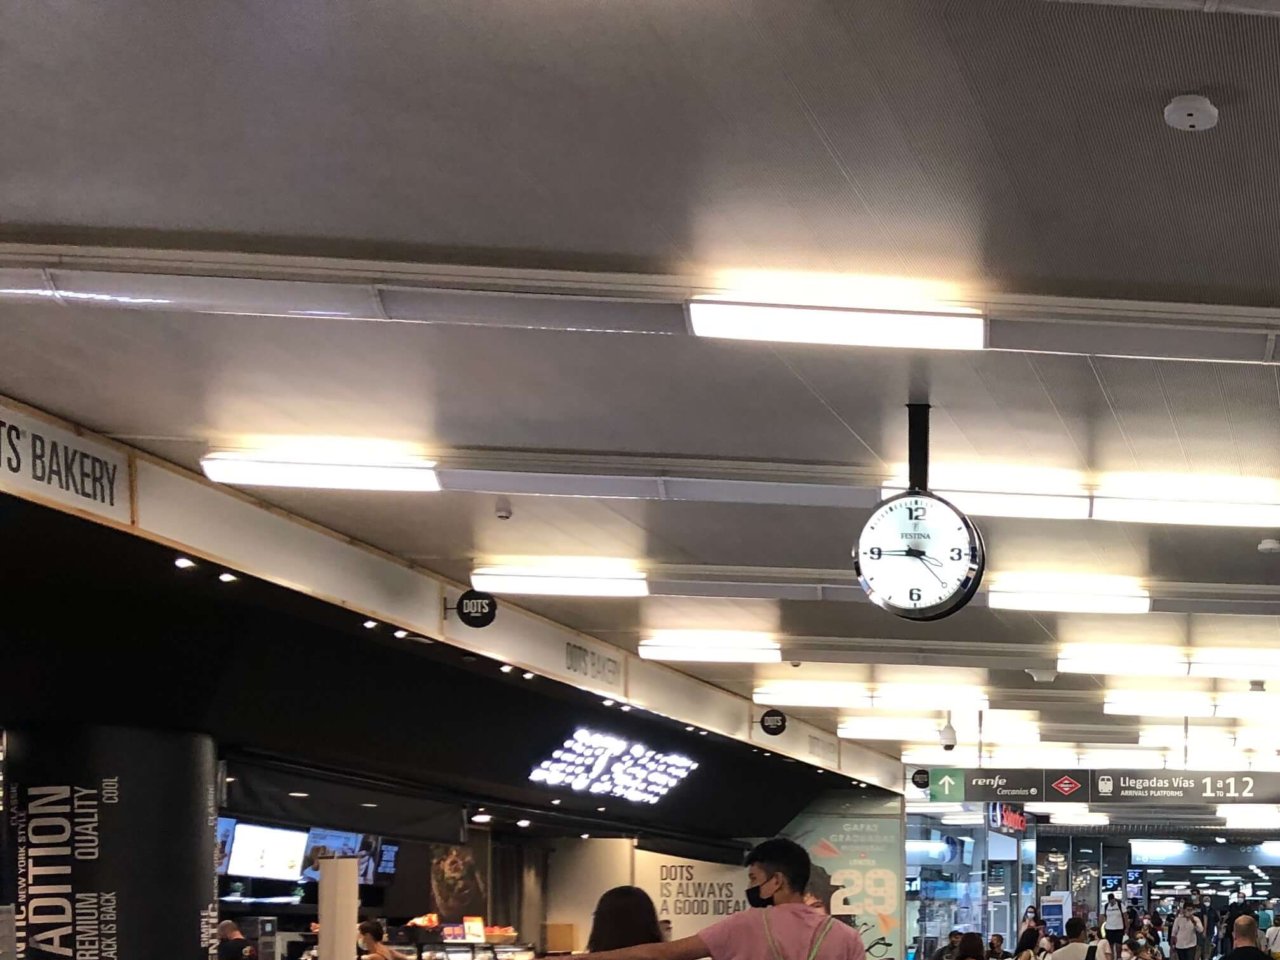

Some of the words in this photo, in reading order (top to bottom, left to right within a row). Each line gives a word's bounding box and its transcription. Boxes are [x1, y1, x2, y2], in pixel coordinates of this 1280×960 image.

[32, 433, 117, 506] BAKERY
[906, 507, 927, 520] 12
[900, 532, 931, 540] FESTINA
[870, 547, 882, 560] 9
[950, 548, 962, 561] 3
[909, 588, 922, 601] 6
[463, 600, 489, 613] DOTS
[972, 775, 1007, 788] renfe
[1120, 776, 1169, 789] Llegadas
[1172, 776, 1195, 788] Vías
[1202, 777, 1215, 797] 1
[1225, 777, 1254, 797] 12
[102, 776, 119, 804] COOL
[74, 786, 99, 860] QUALITY
[18, 846, 26, 874] YORK
[661, 865, 694, 881] DOTS
[18, 877, 27, 902] NEW
[661, 883, 672, 898] IS
[676, 883, 734, 898] ALWAYS
[830, 869, 898, 916] 29
[100, 892, 117, 921] BACK
[660, 900, 669, 915] A
[674, 900, 709, 915] GOOD
[100, 923, 117, 934] IS
